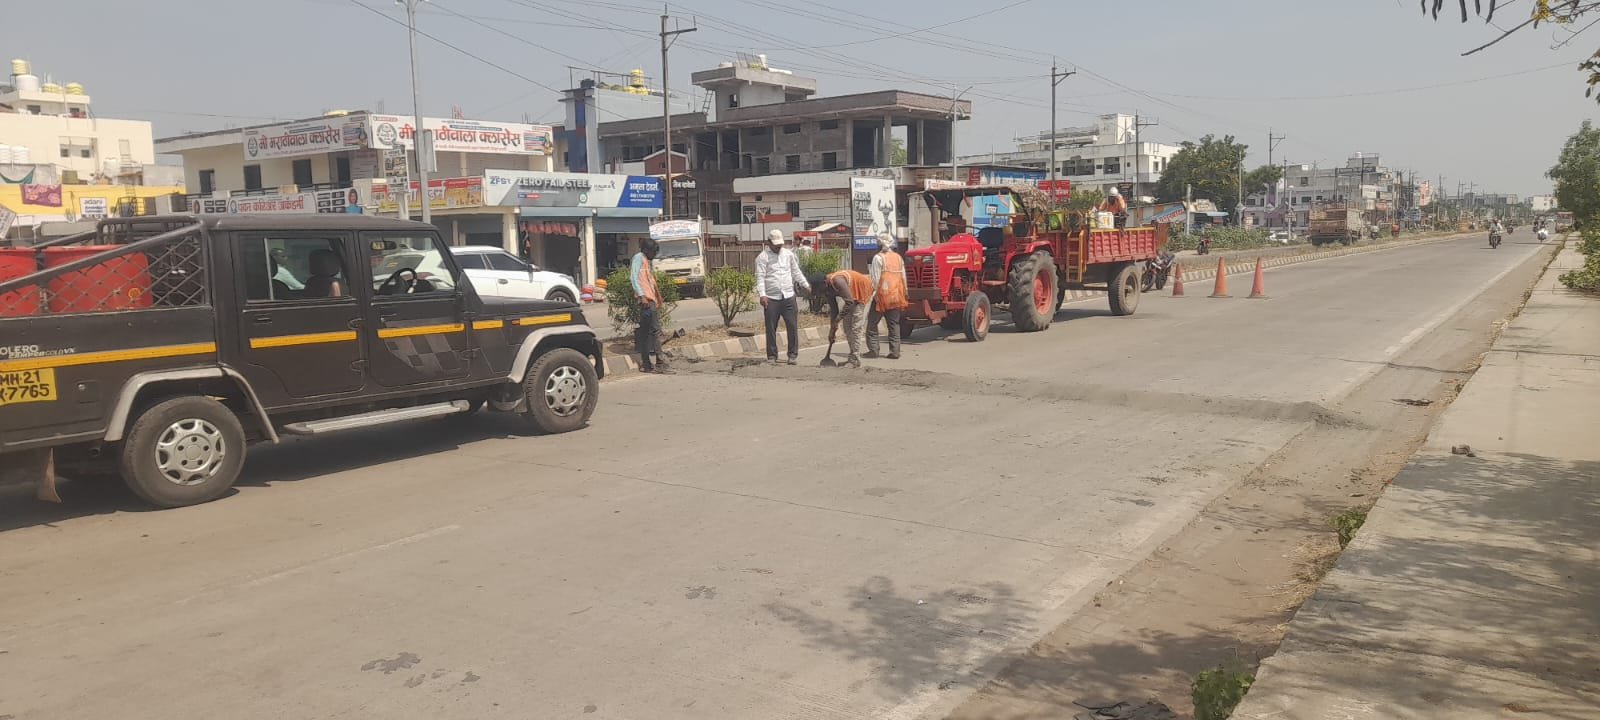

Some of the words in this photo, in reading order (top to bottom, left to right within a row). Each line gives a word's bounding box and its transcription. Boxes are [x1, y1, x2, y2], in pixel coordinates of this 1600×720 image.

[309, 125, 340, 145] क्लासेस
[399, 123, 414, 140] मी
[434, 124, 477, 143] ाठीवाला
[479, 128, 521, 146] क्लासेस
[517, 178, 542, 187] ZERO
[544, 179, 564, 188] FAIL
[566, 179, 591, 189] STEEL
